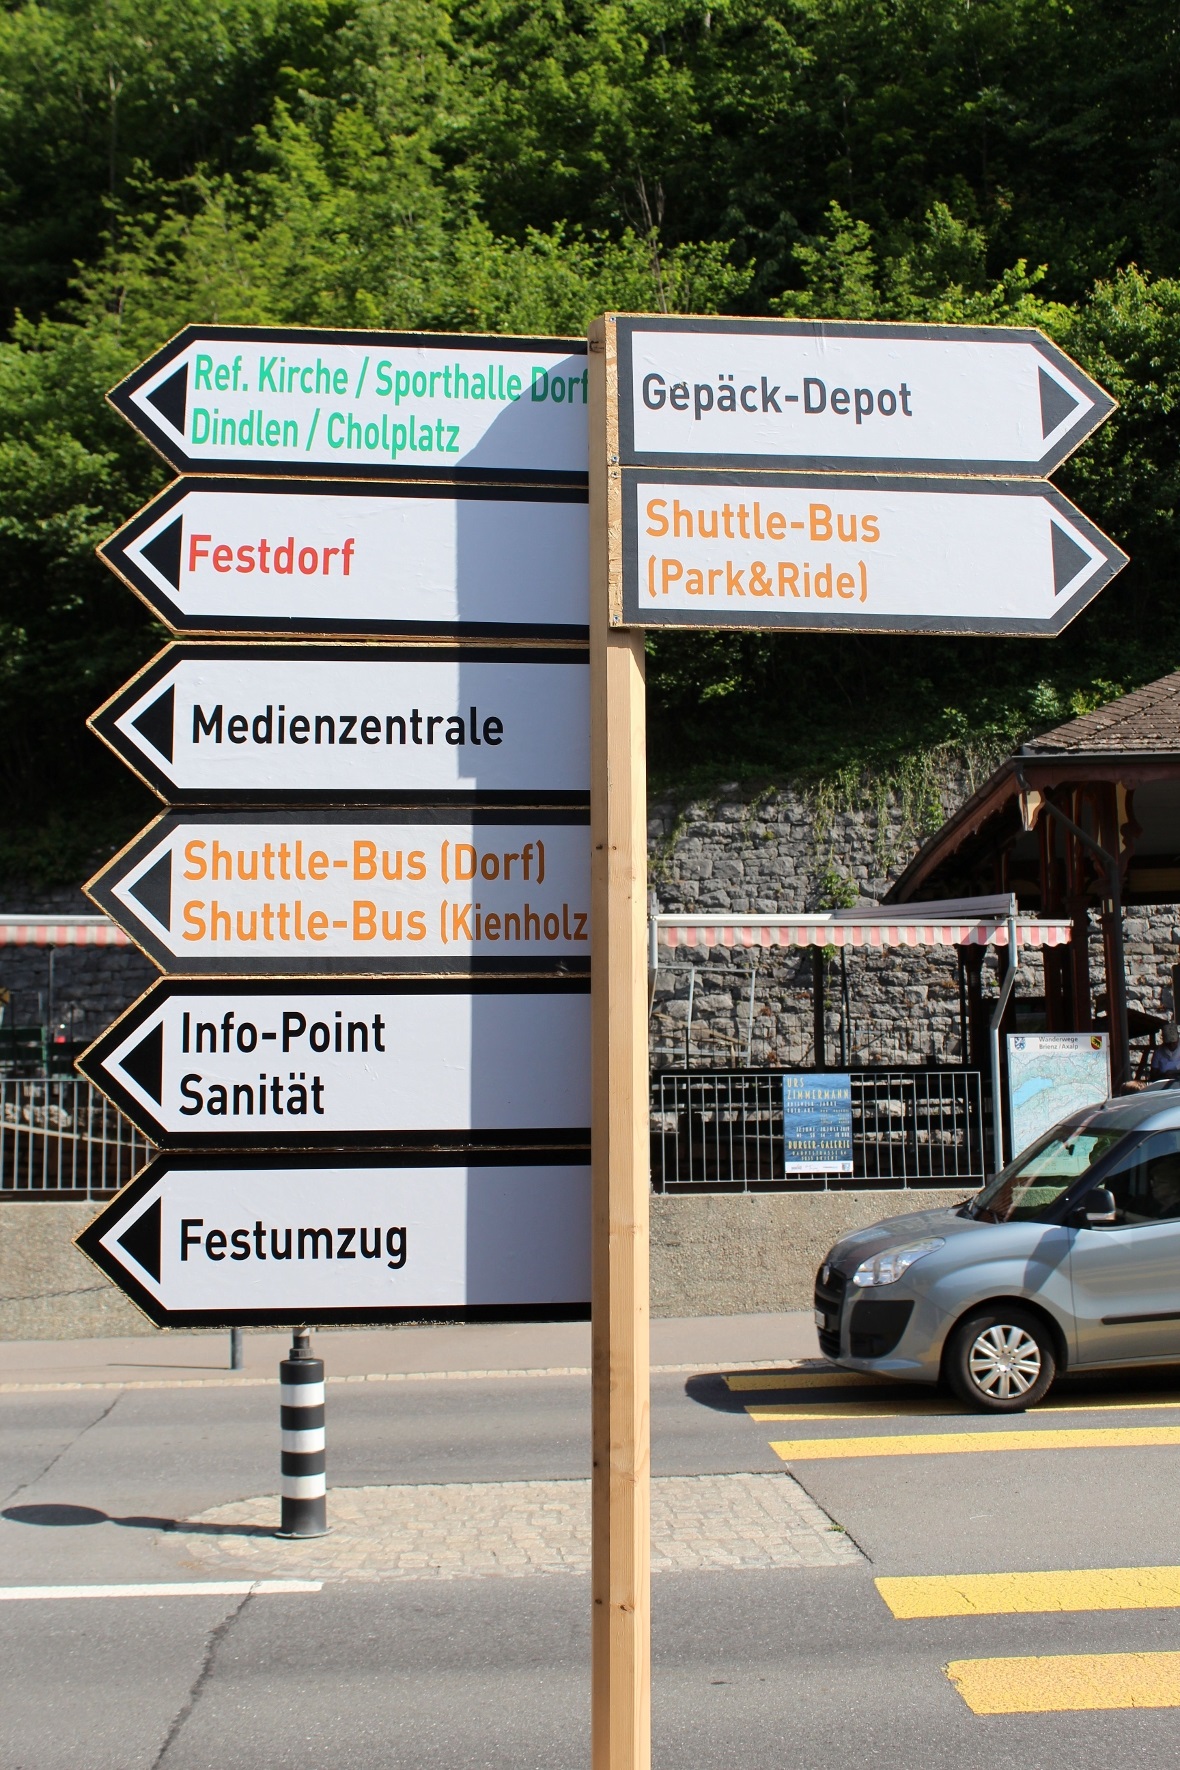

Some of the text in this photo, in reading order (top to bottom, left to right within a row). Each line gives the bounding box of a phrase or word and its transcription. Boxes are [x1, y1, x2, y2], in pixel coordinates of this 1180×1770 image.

[194, 353, 248, 391] Ref.
[643, 374, 912, 424] Gepäck-Depot
[191, 407, 298, 447] Dindlen
[326, 411, 460, 460] Cholplatz
[646, 499, 880, 543] Shuttle-Bus
[189, 534, 355, 576] Festdorf
[648, 555, 867, 603] (Park&Ride)
[193, 705, 503, 745] Medienzentrale
[183, 839, 544, 884] Shuttle-Bus (Dorf)
[182, 900, 427, 942] Shuttle-Bus
[183, 1011, 385, 1053] Info-Point
[180, 1073, 324, 1115] Sanität
[787, 1077, 804, 1088] URS
[787, 1089, 849, 1100] ZIMMERMANN
[181, 1219, 406, 1269] Festumzug
